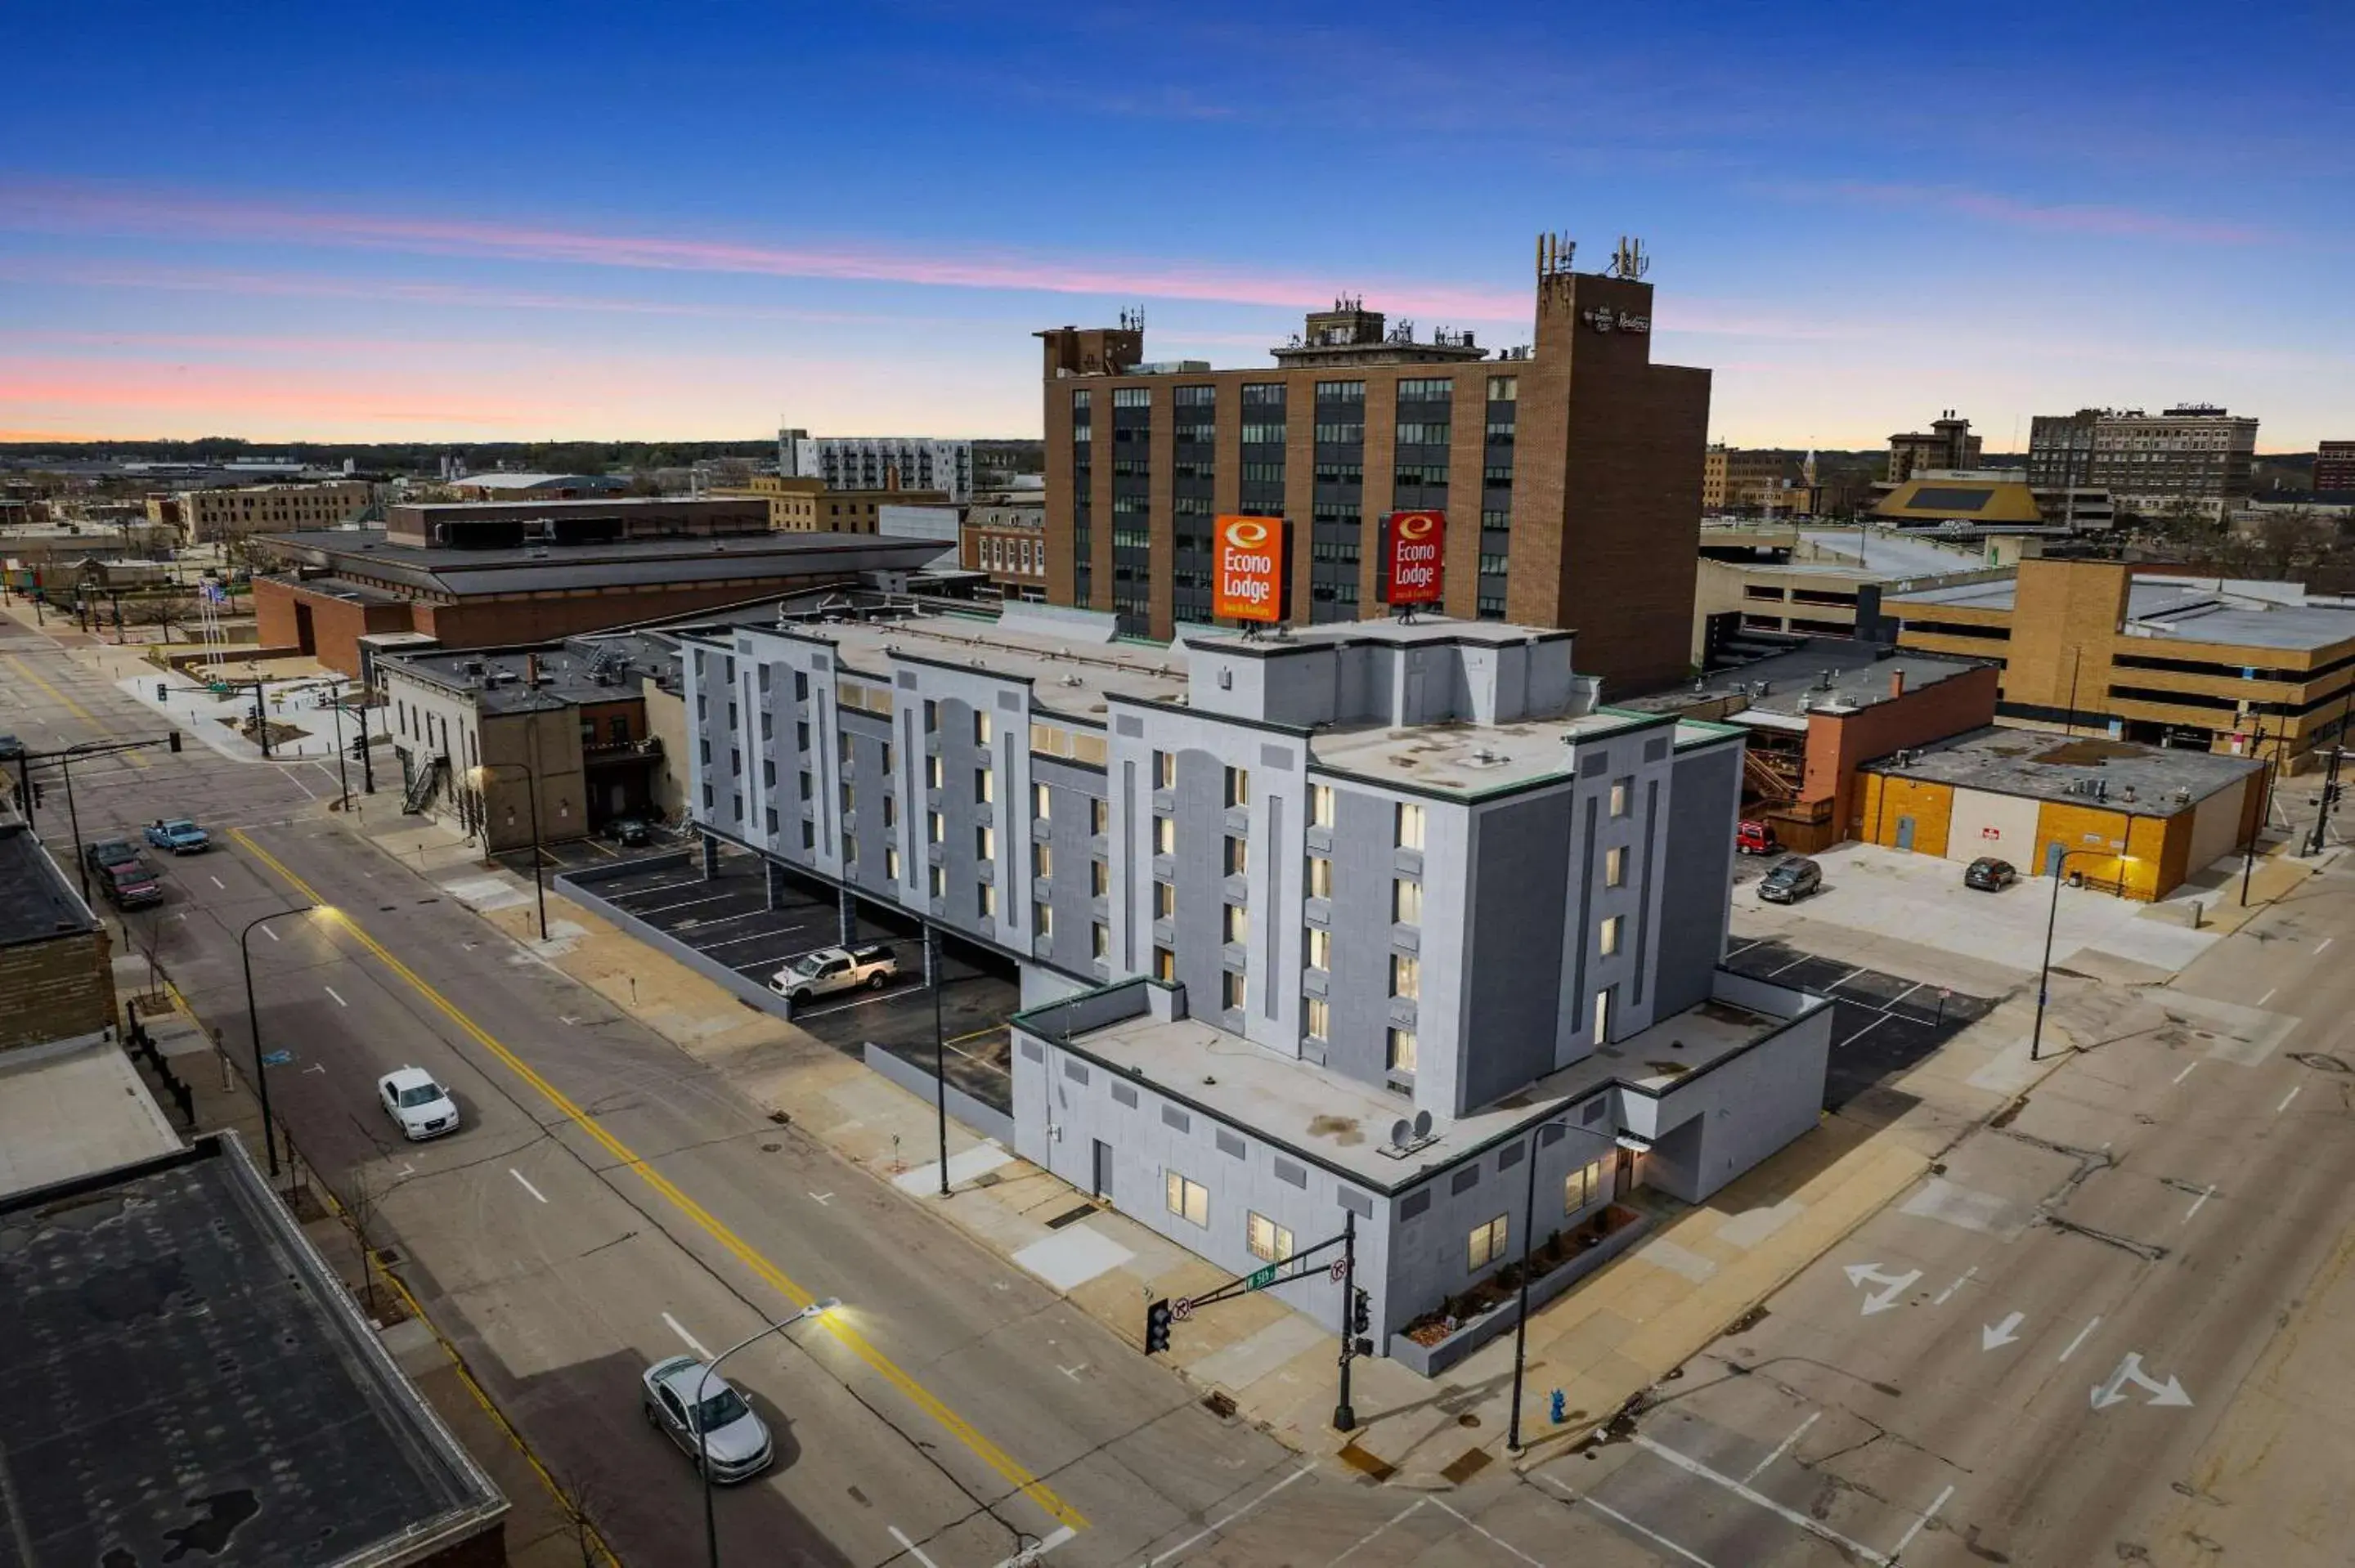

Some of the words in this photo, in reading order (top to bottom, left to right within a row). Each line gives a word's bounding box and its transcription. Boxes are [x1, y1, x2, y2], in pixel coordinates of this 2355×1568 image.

[1224, 547, 1271, 573] Econo
[1396, 540, 1434, 562] Econo
[1224, 572, 1270, 603] Lodge
[1396, 562, 1433, 588] Lodge
